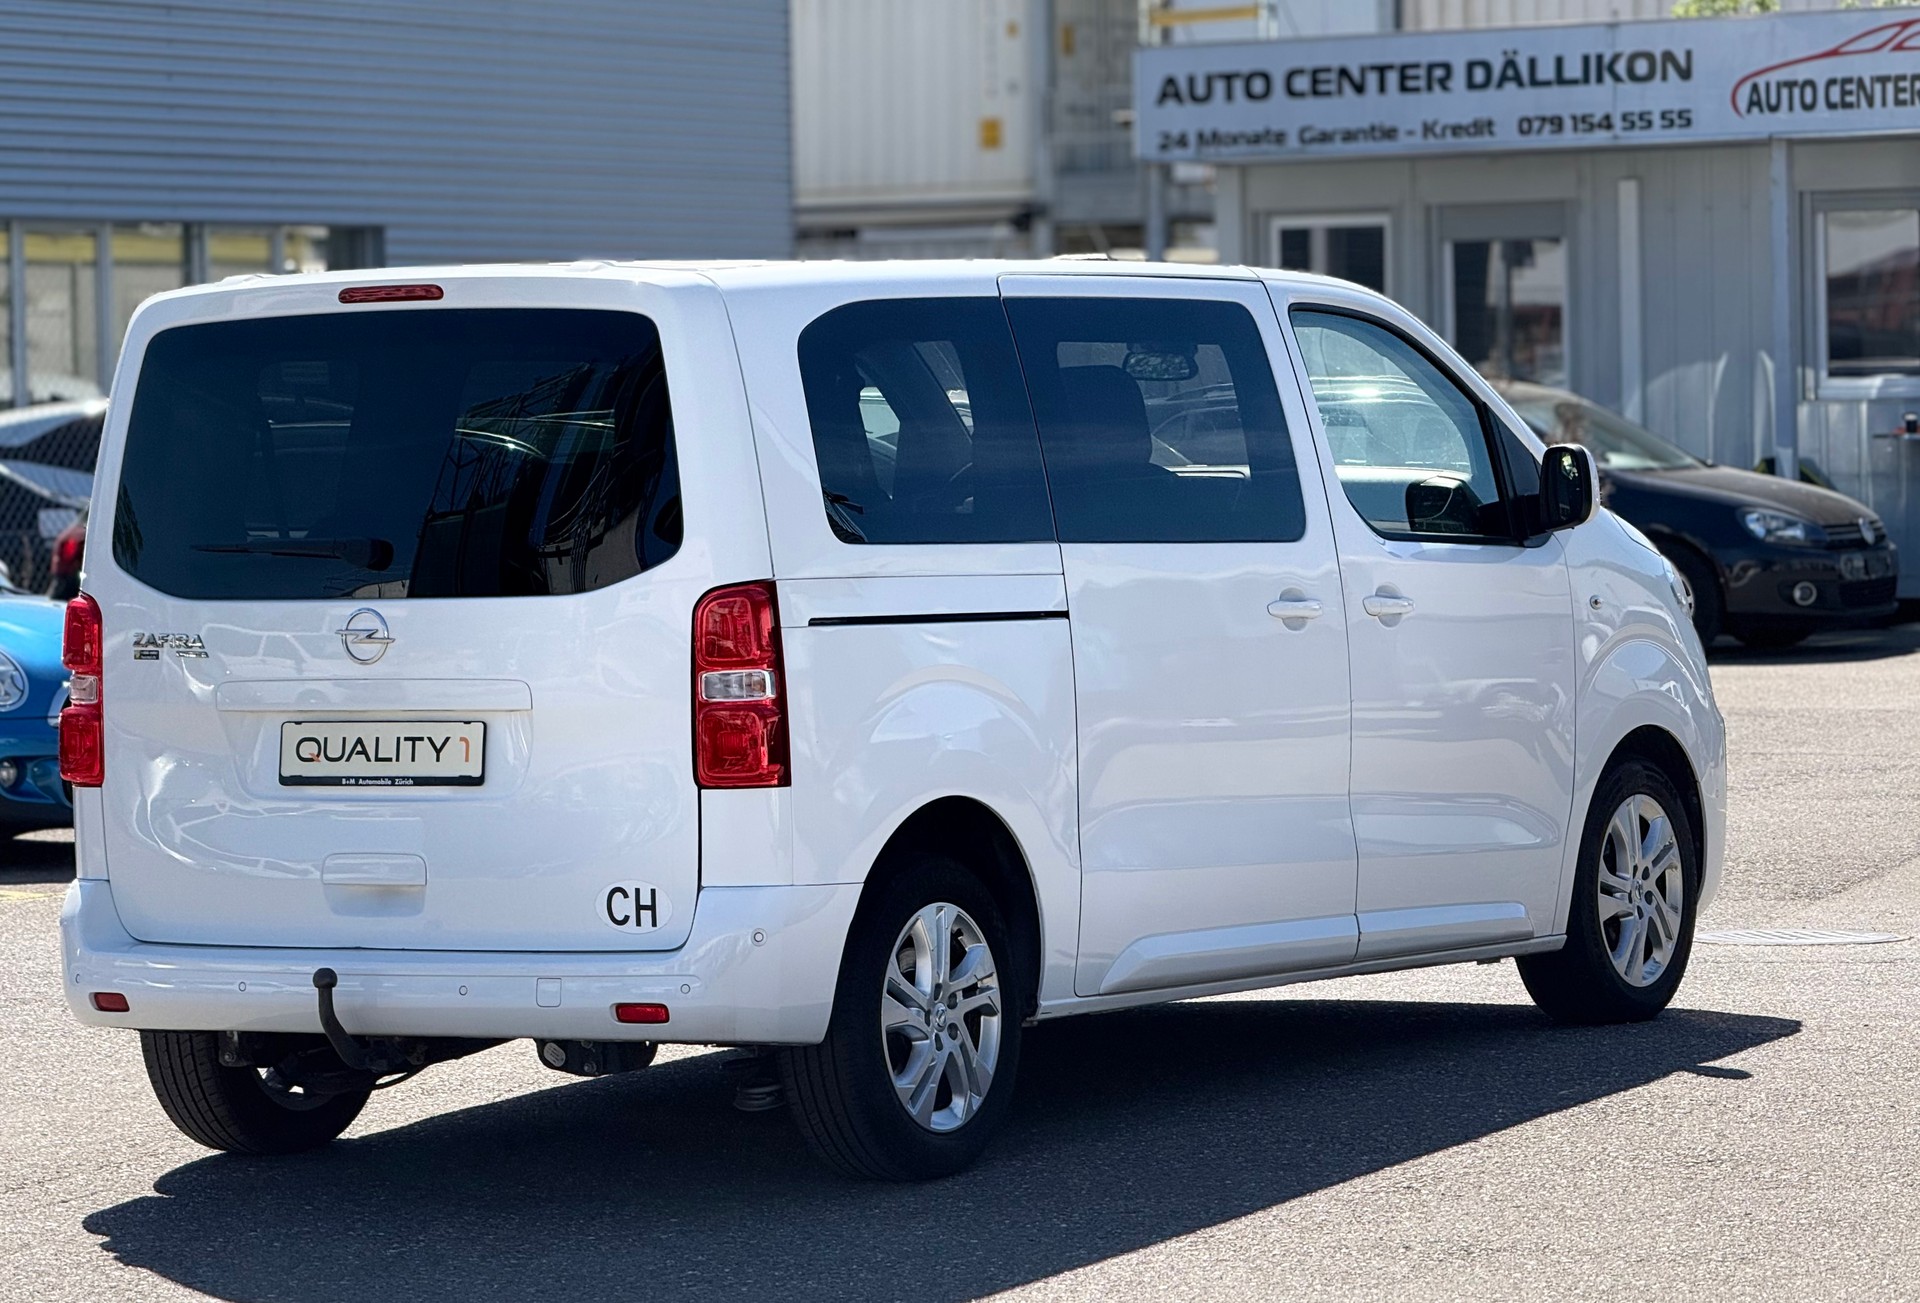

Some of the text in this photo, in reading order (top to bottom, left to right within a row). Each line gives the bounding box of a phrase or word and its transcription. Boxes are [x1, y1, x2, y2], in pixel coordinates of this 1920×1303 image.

[1157, 49, 1693, 107] AUTO CENTER DÄLLIKON
[1746, 79, 1818, 115] AUTO
[1158, 130, 1190, 152] 24
[1196, 126, 1287, 149] Monate
[1298, 121, 1399, 145] Garantie
[1421, 117, 1496, 141] Kredit
[1517, 115, 1564, 137] 079
[1570, 112, 1614, 135] 154
[1621, 111, 1653, 132] 55
[1660, 108, 1692, 130] 55
[133, 632, 205, 650] ZAFIRA
[295, 736, 470, 763] QUALITY 1
[606, 886, 657, 928] CH
